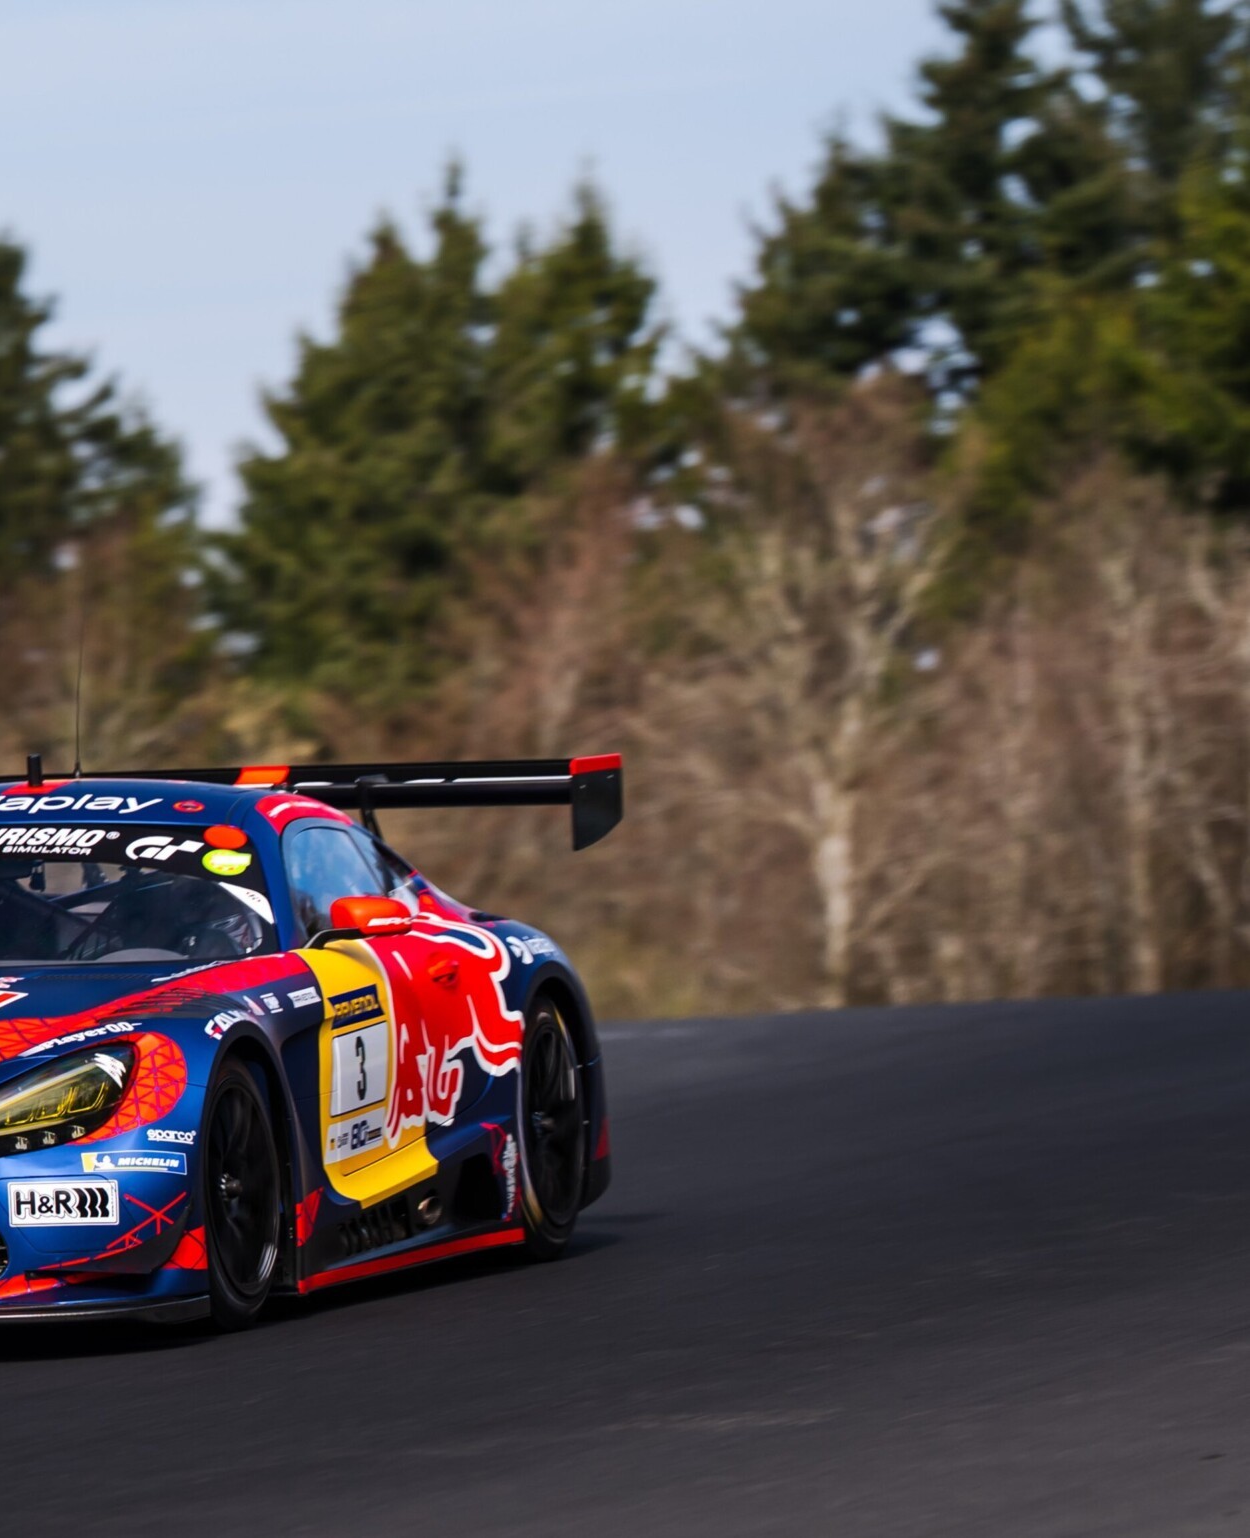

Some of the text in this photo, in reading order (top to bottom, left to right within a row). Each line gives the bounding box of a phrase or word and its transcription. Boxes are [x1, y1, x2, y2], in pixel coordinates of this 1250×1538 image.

[2, 846, 92, 856] SIMULATOR
[355, 1036, 367, 1101] 3
[117, 1157, 179, 1168] MICHELIN
[15, 1190, 73, 1216] H&R
